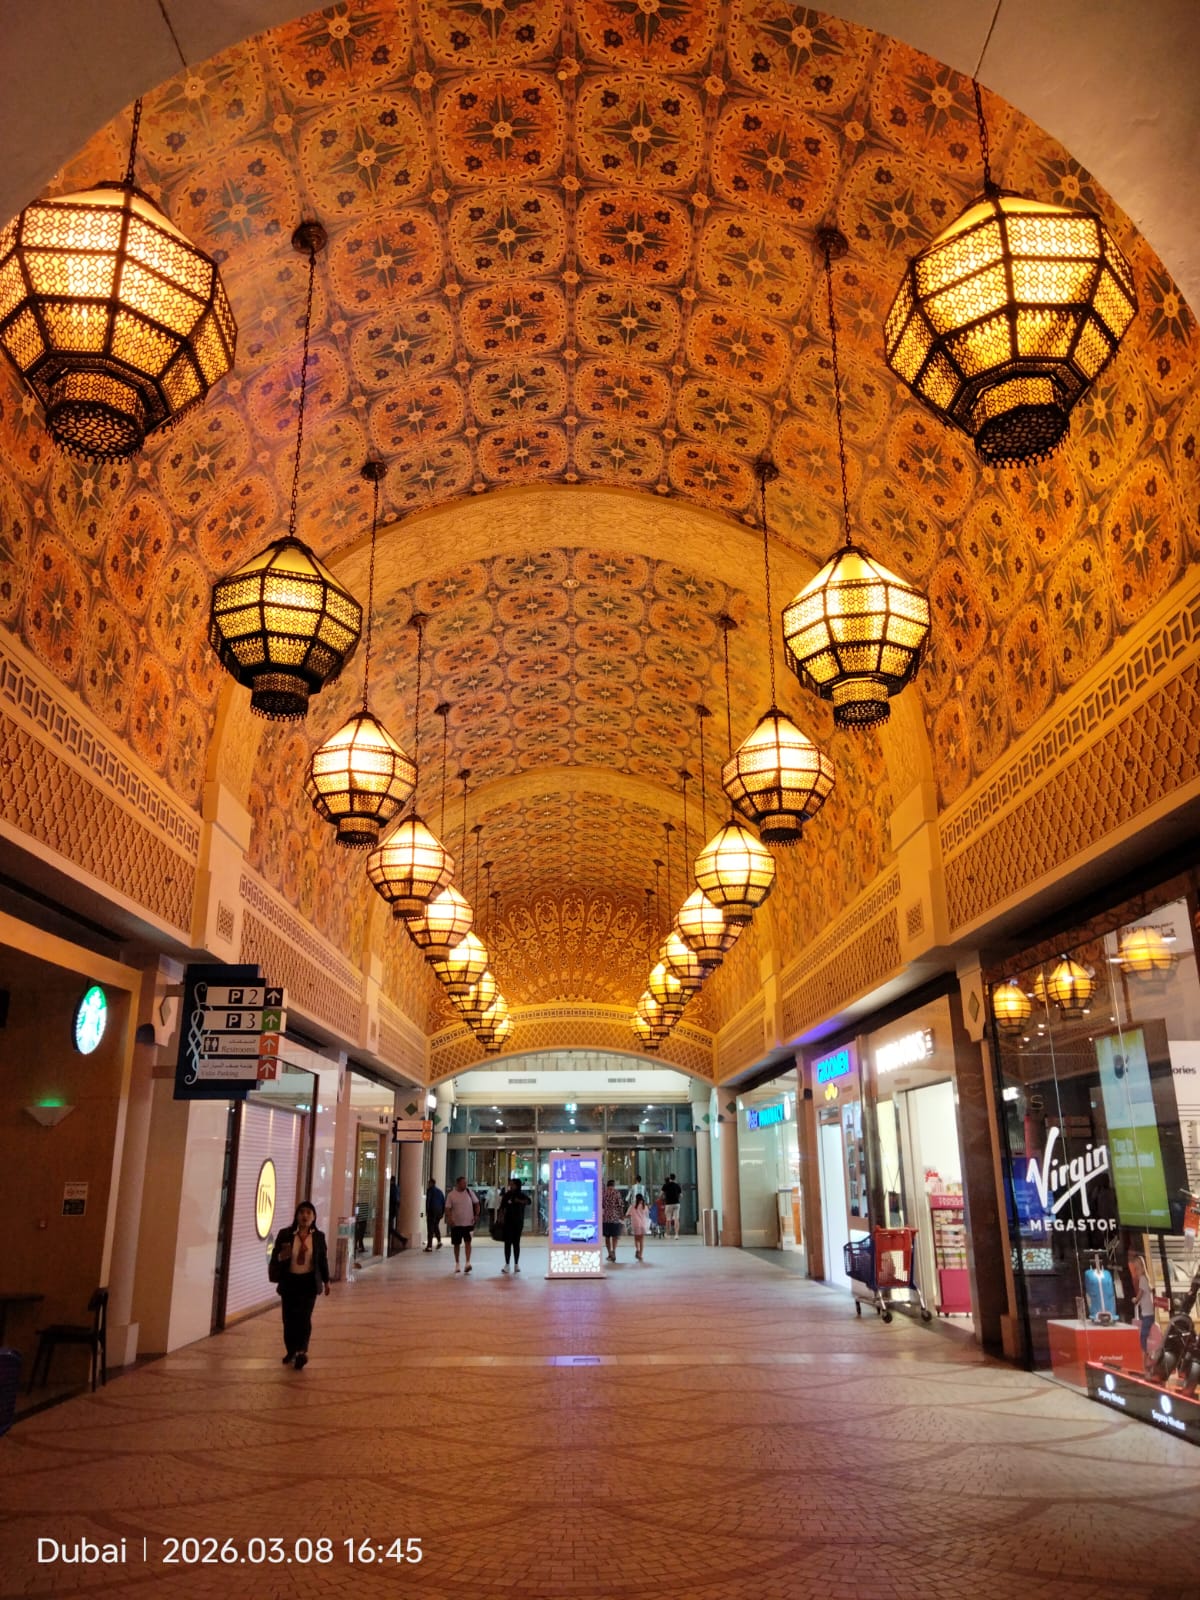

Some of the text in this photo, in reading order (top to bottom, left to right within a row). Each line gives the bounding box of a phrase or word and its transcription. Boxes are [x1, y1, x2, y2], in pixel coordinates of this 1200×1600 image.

[248, 989, 258, 1005] 2
[246, 1013, 256, 1029] 3
[1026, 1126, 1109, 1217] Virgin
